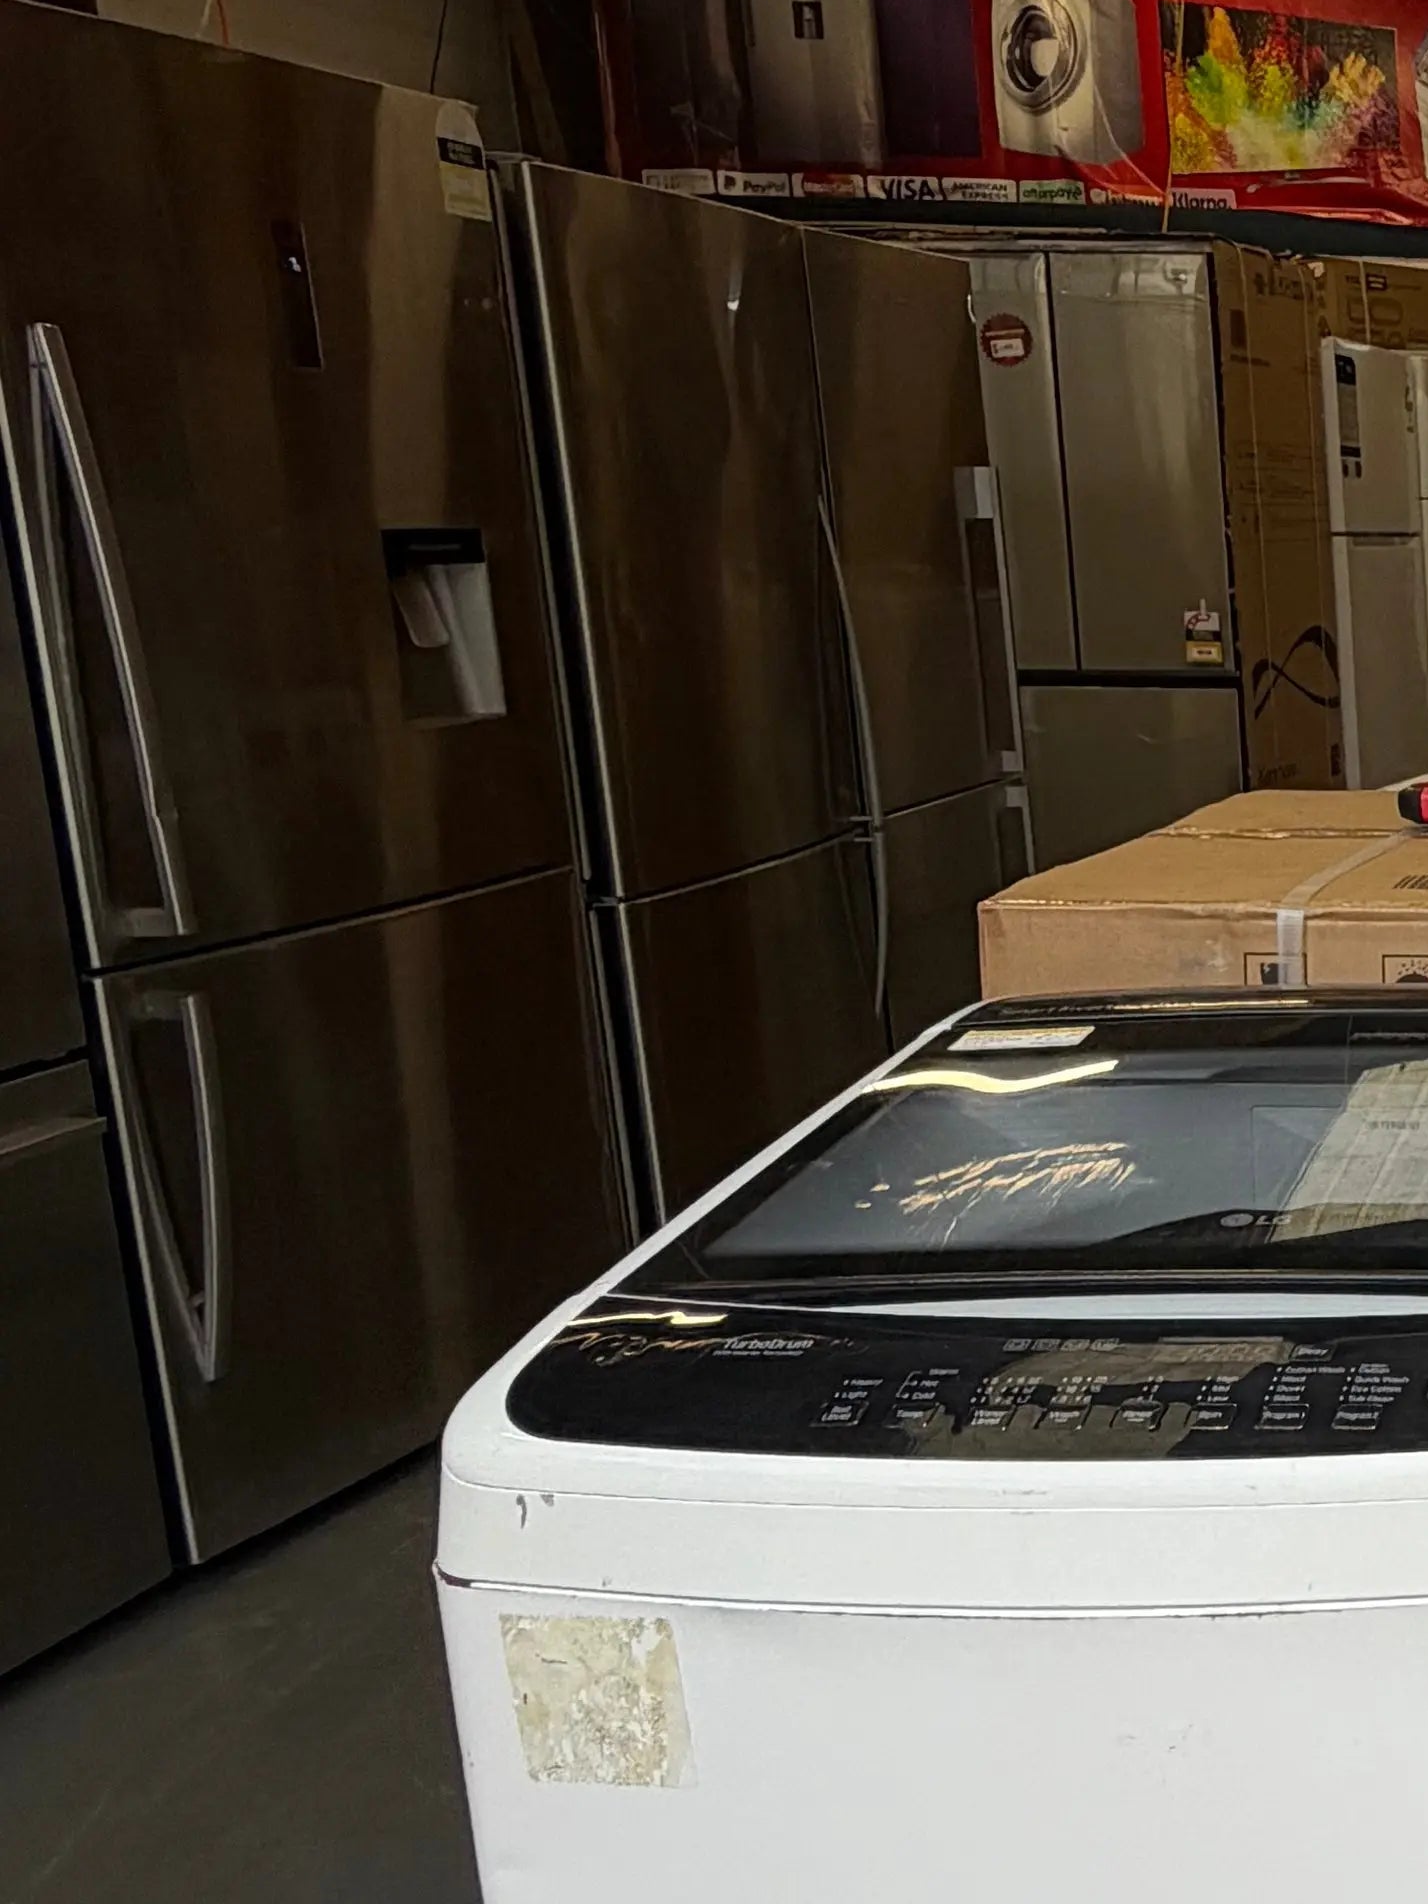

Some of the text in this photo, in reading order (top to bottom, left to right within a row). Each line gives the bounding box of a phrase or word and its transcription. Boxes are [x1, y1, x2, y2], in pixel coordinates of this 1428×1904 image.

[743, 180, 786, 194] PayPal
[879, 177, 933, 201] VISA
[951, 181, 1008, 192] AMERICAN
[723, 1337, 815, 1350] TurboDrum
